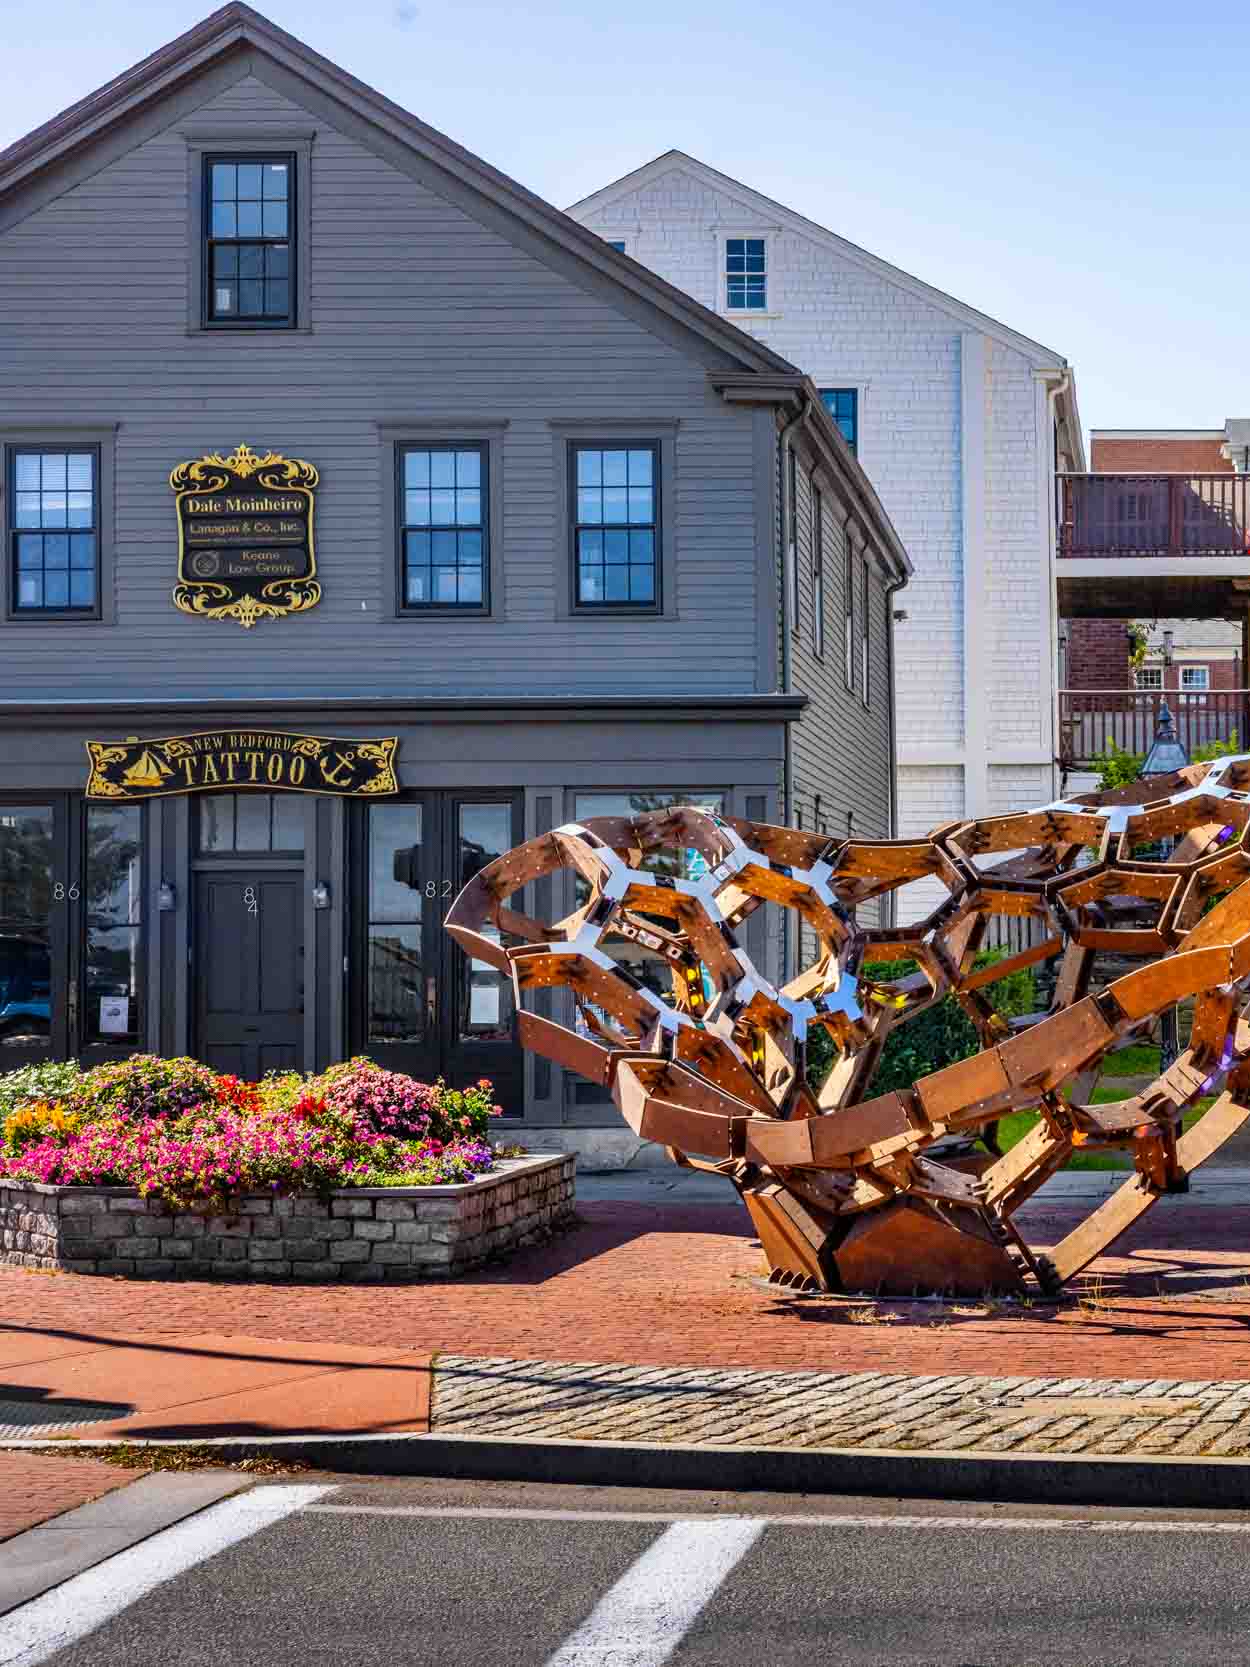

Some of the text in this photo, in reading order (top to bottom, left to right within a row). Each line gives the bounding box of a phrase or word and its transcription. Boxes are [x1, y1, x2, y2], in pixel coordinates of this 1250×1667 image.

[188, 497, 303, 513] Dale Moinheiro
[242, 551, 281, 561] Keane
[193, 735, 292, 751] NEW BEDFORD
[178, 751, 305, 786] TATTOO
[53, 881, 81, 900] 86
[425, 879, 453, 898] 82
